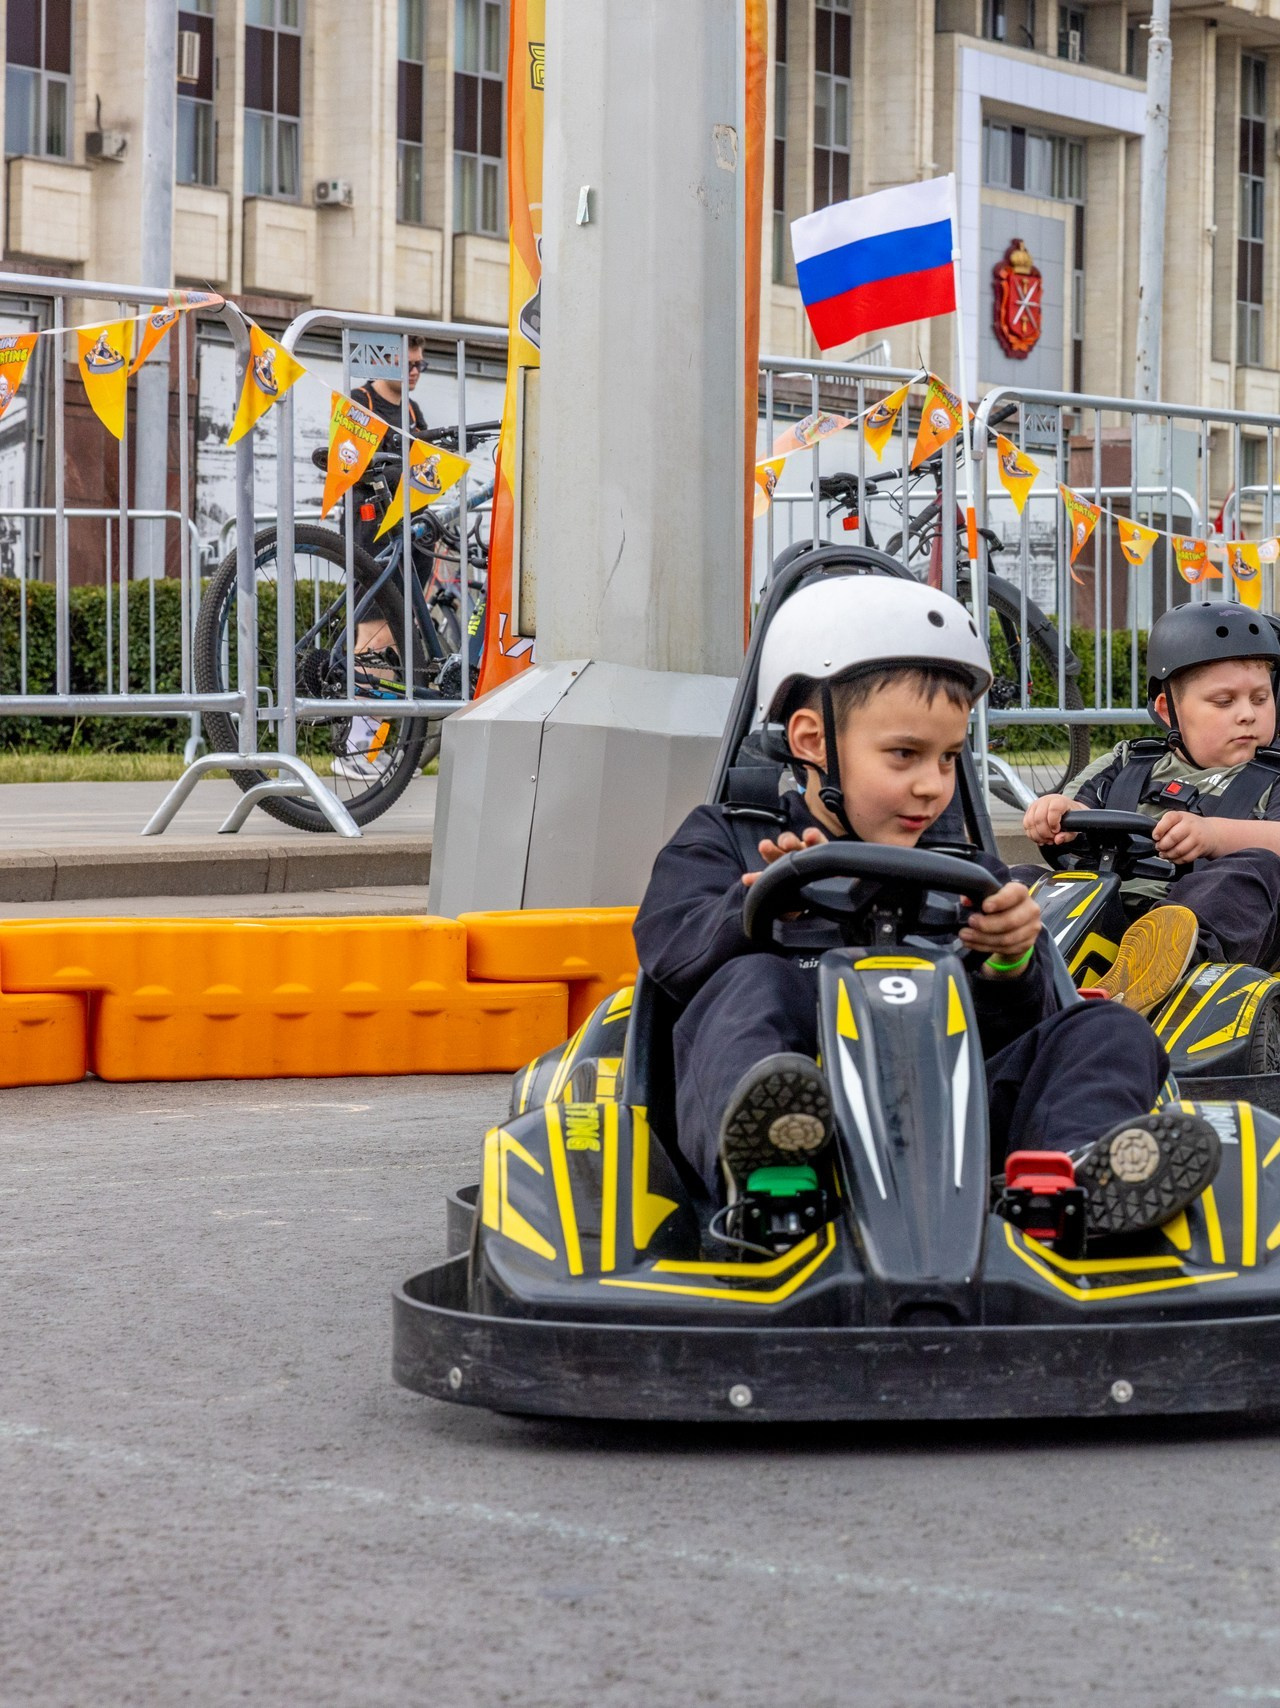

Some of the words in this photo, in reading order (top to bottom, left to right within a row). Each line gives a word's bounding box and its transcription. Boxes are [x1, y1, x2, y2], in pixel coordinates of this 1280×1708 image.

[334, 410, 379, 445] KARTING
[346, 405, 371, 427] MINI
[1047, 882, 1076, 898] 7
[879, 976, 918, 1005] 9
